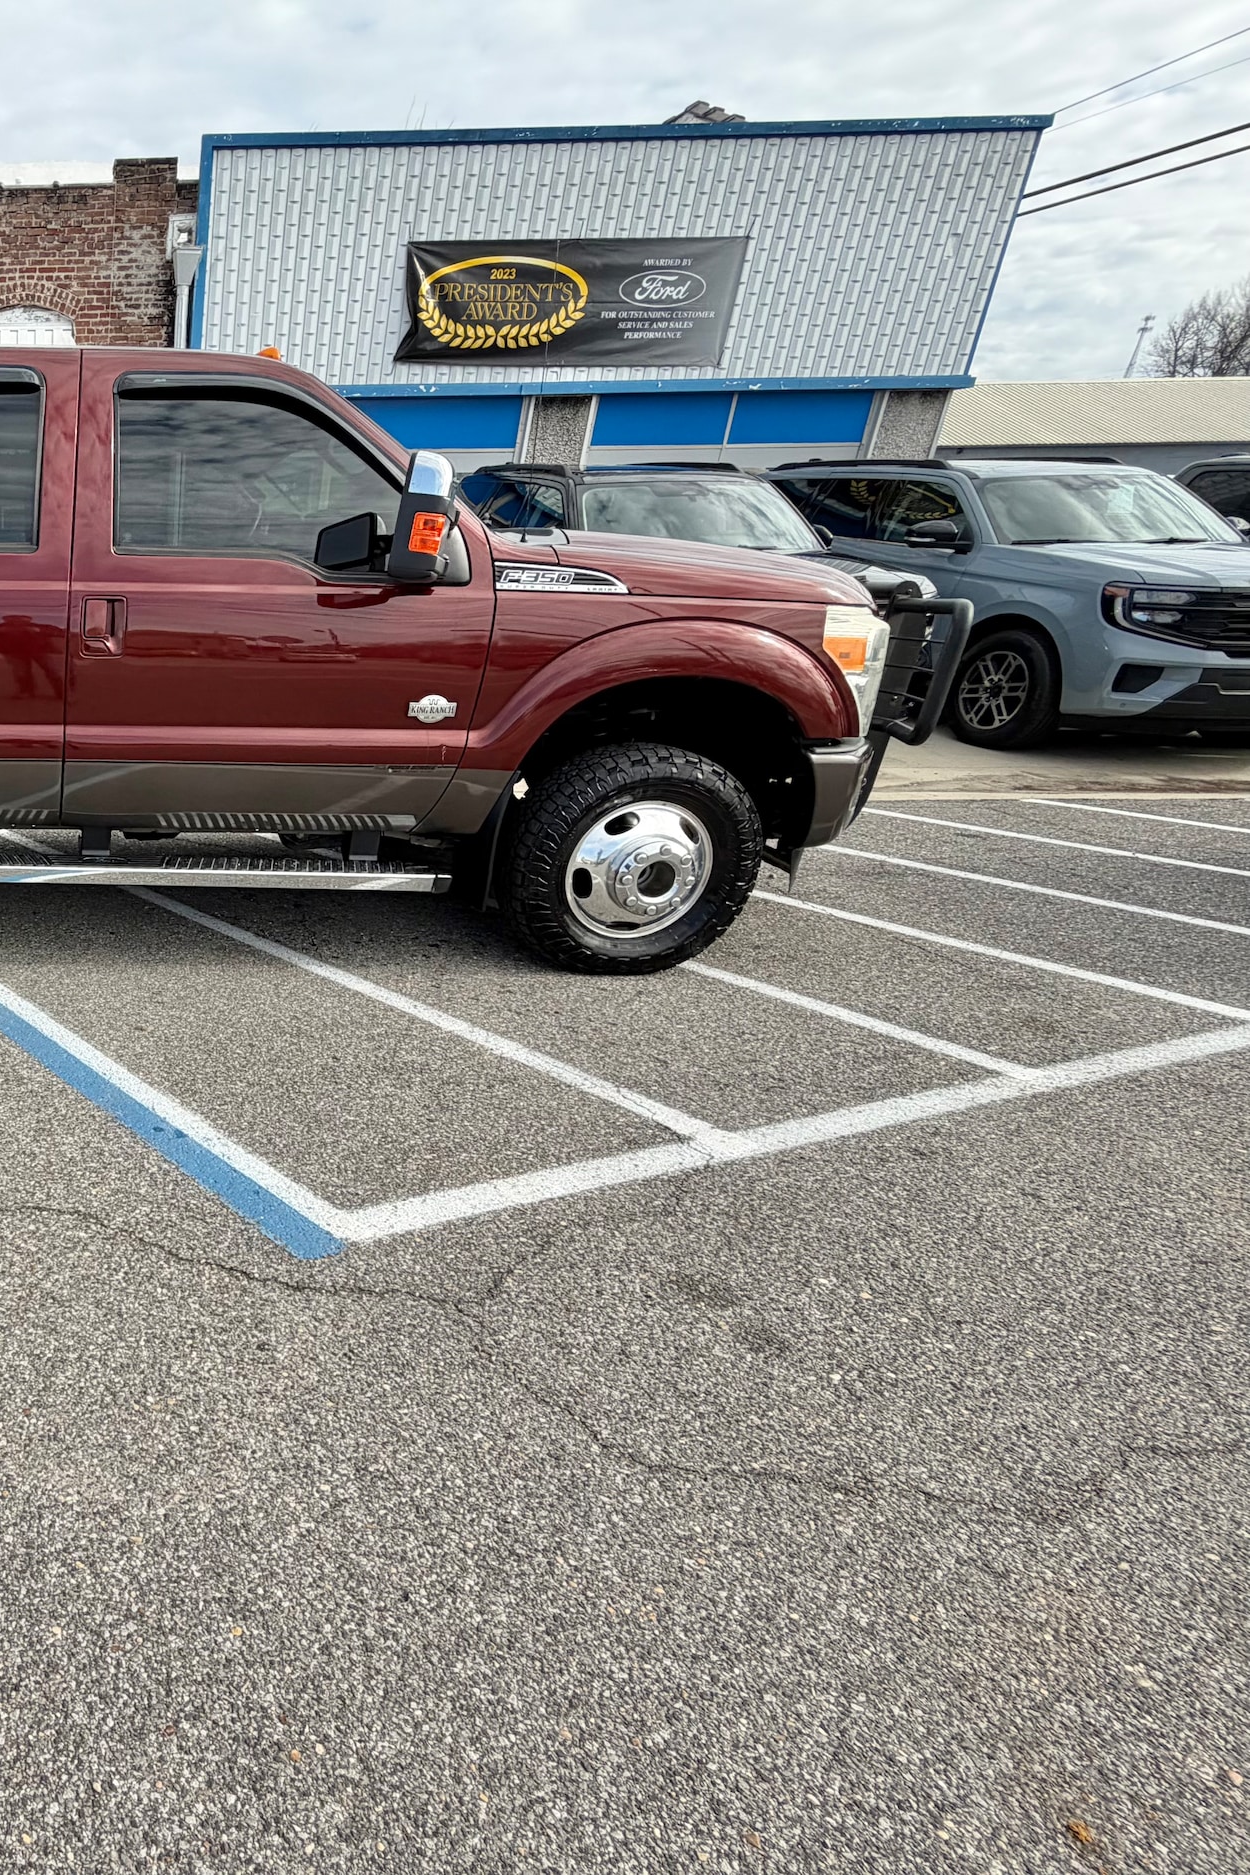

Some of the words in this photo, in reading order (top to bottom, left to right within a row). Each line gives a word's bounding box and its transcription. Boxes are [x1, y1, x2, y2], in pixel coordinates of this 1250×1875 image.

[643, 258, 681, 267] AWARDED
[682, 258, 693, 267] BY
[490, 268, 517, 280] 2023
[634, 274, 692, 300] Ford
[434, 282, 573, 302] PRESIDENT'S
[461, 302, 538, 320] AWARD
[600, 311, 617, 319] FOR
[618, 310, 671, 319] OUTSTANDING
[672, 310, 715, 318] CUSTOMER
[617, 321, 651, 329] SERVICE
[651, 321, 668, 329] AND
[669, 321, 694, 329] SALES
[623, 331, 682, 340] PERFORMANCE
[411, 705, 429, 714] KING
[430, 706, 455, 714] RANCH
